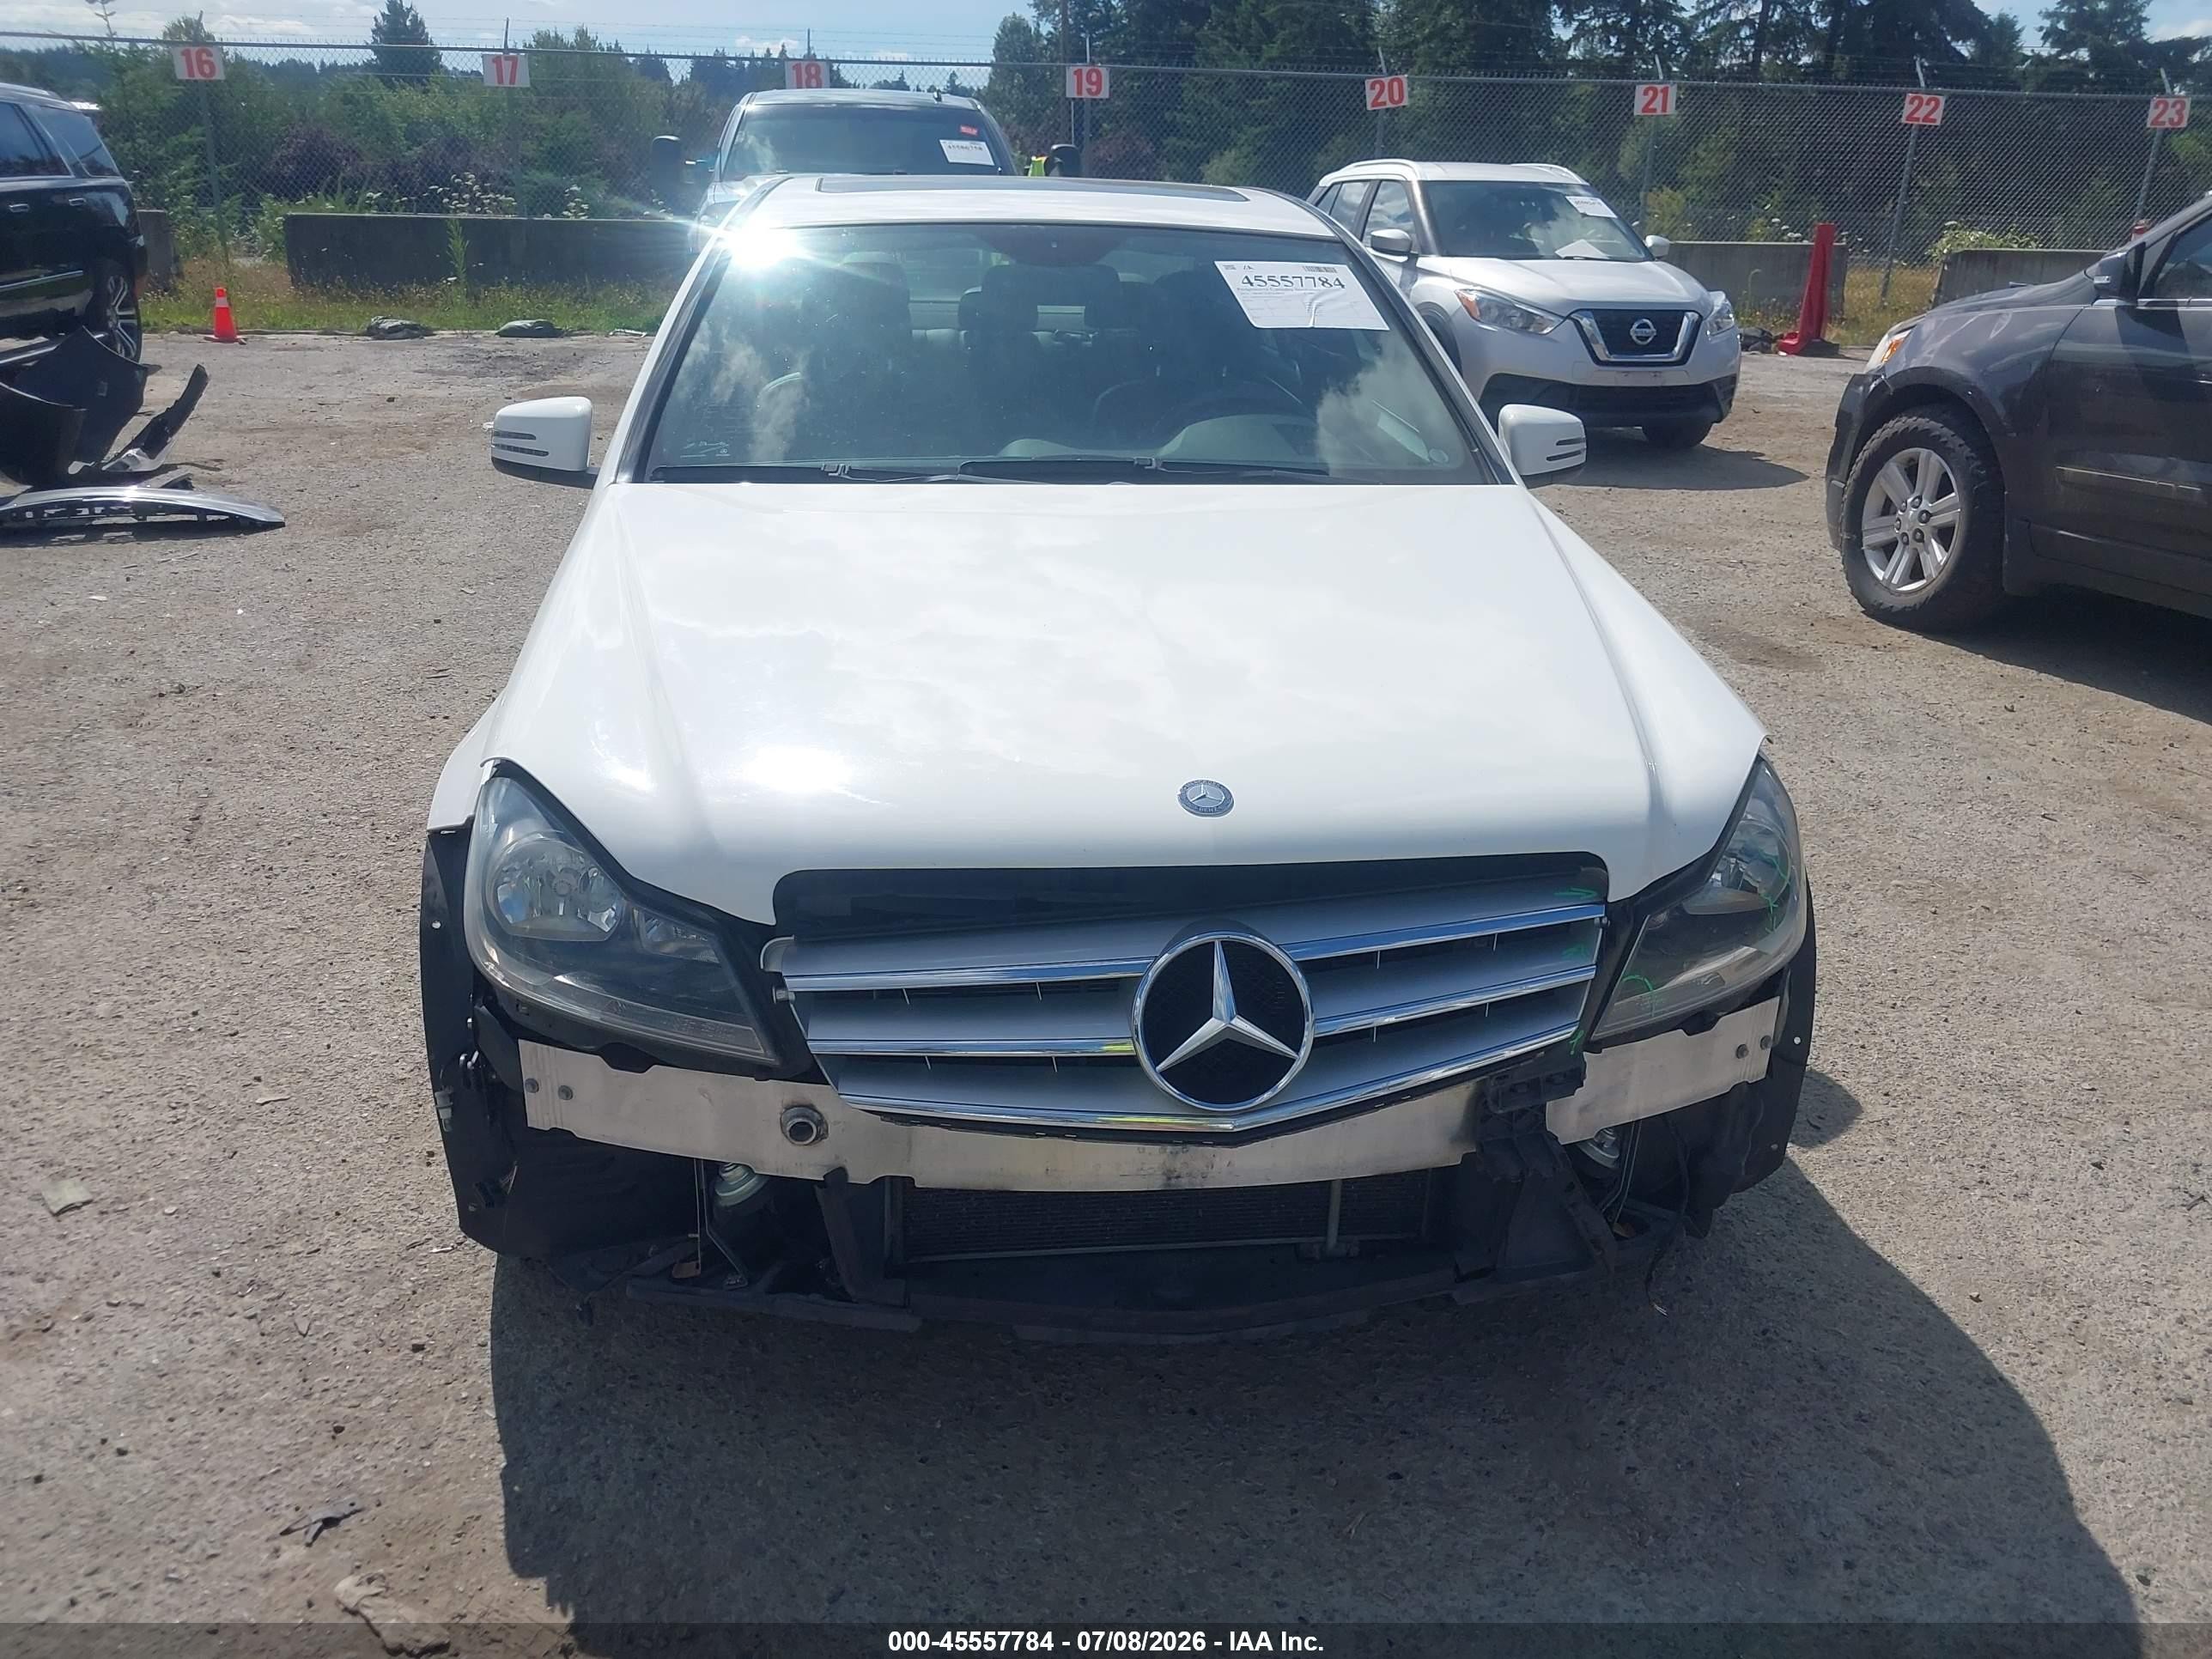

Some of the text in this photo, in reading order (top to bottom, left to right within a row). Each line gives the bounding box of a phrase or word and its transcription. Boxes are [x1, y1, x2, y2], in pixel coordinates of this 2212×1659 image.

[181, 47, 216, 78] 16
[492, 56, 518, 86] 17
[792, 63, 823, 88] 18
[1073, 68, 1103, 97] 19
[1370, 77, 1404, 107] 20
[1641, 86, 1669, 113] 21
[1905, 94, 1941, 124] 22
[2150, 100, 2186, 127] 23
[1242, 275, 1346, 289] 45557784
